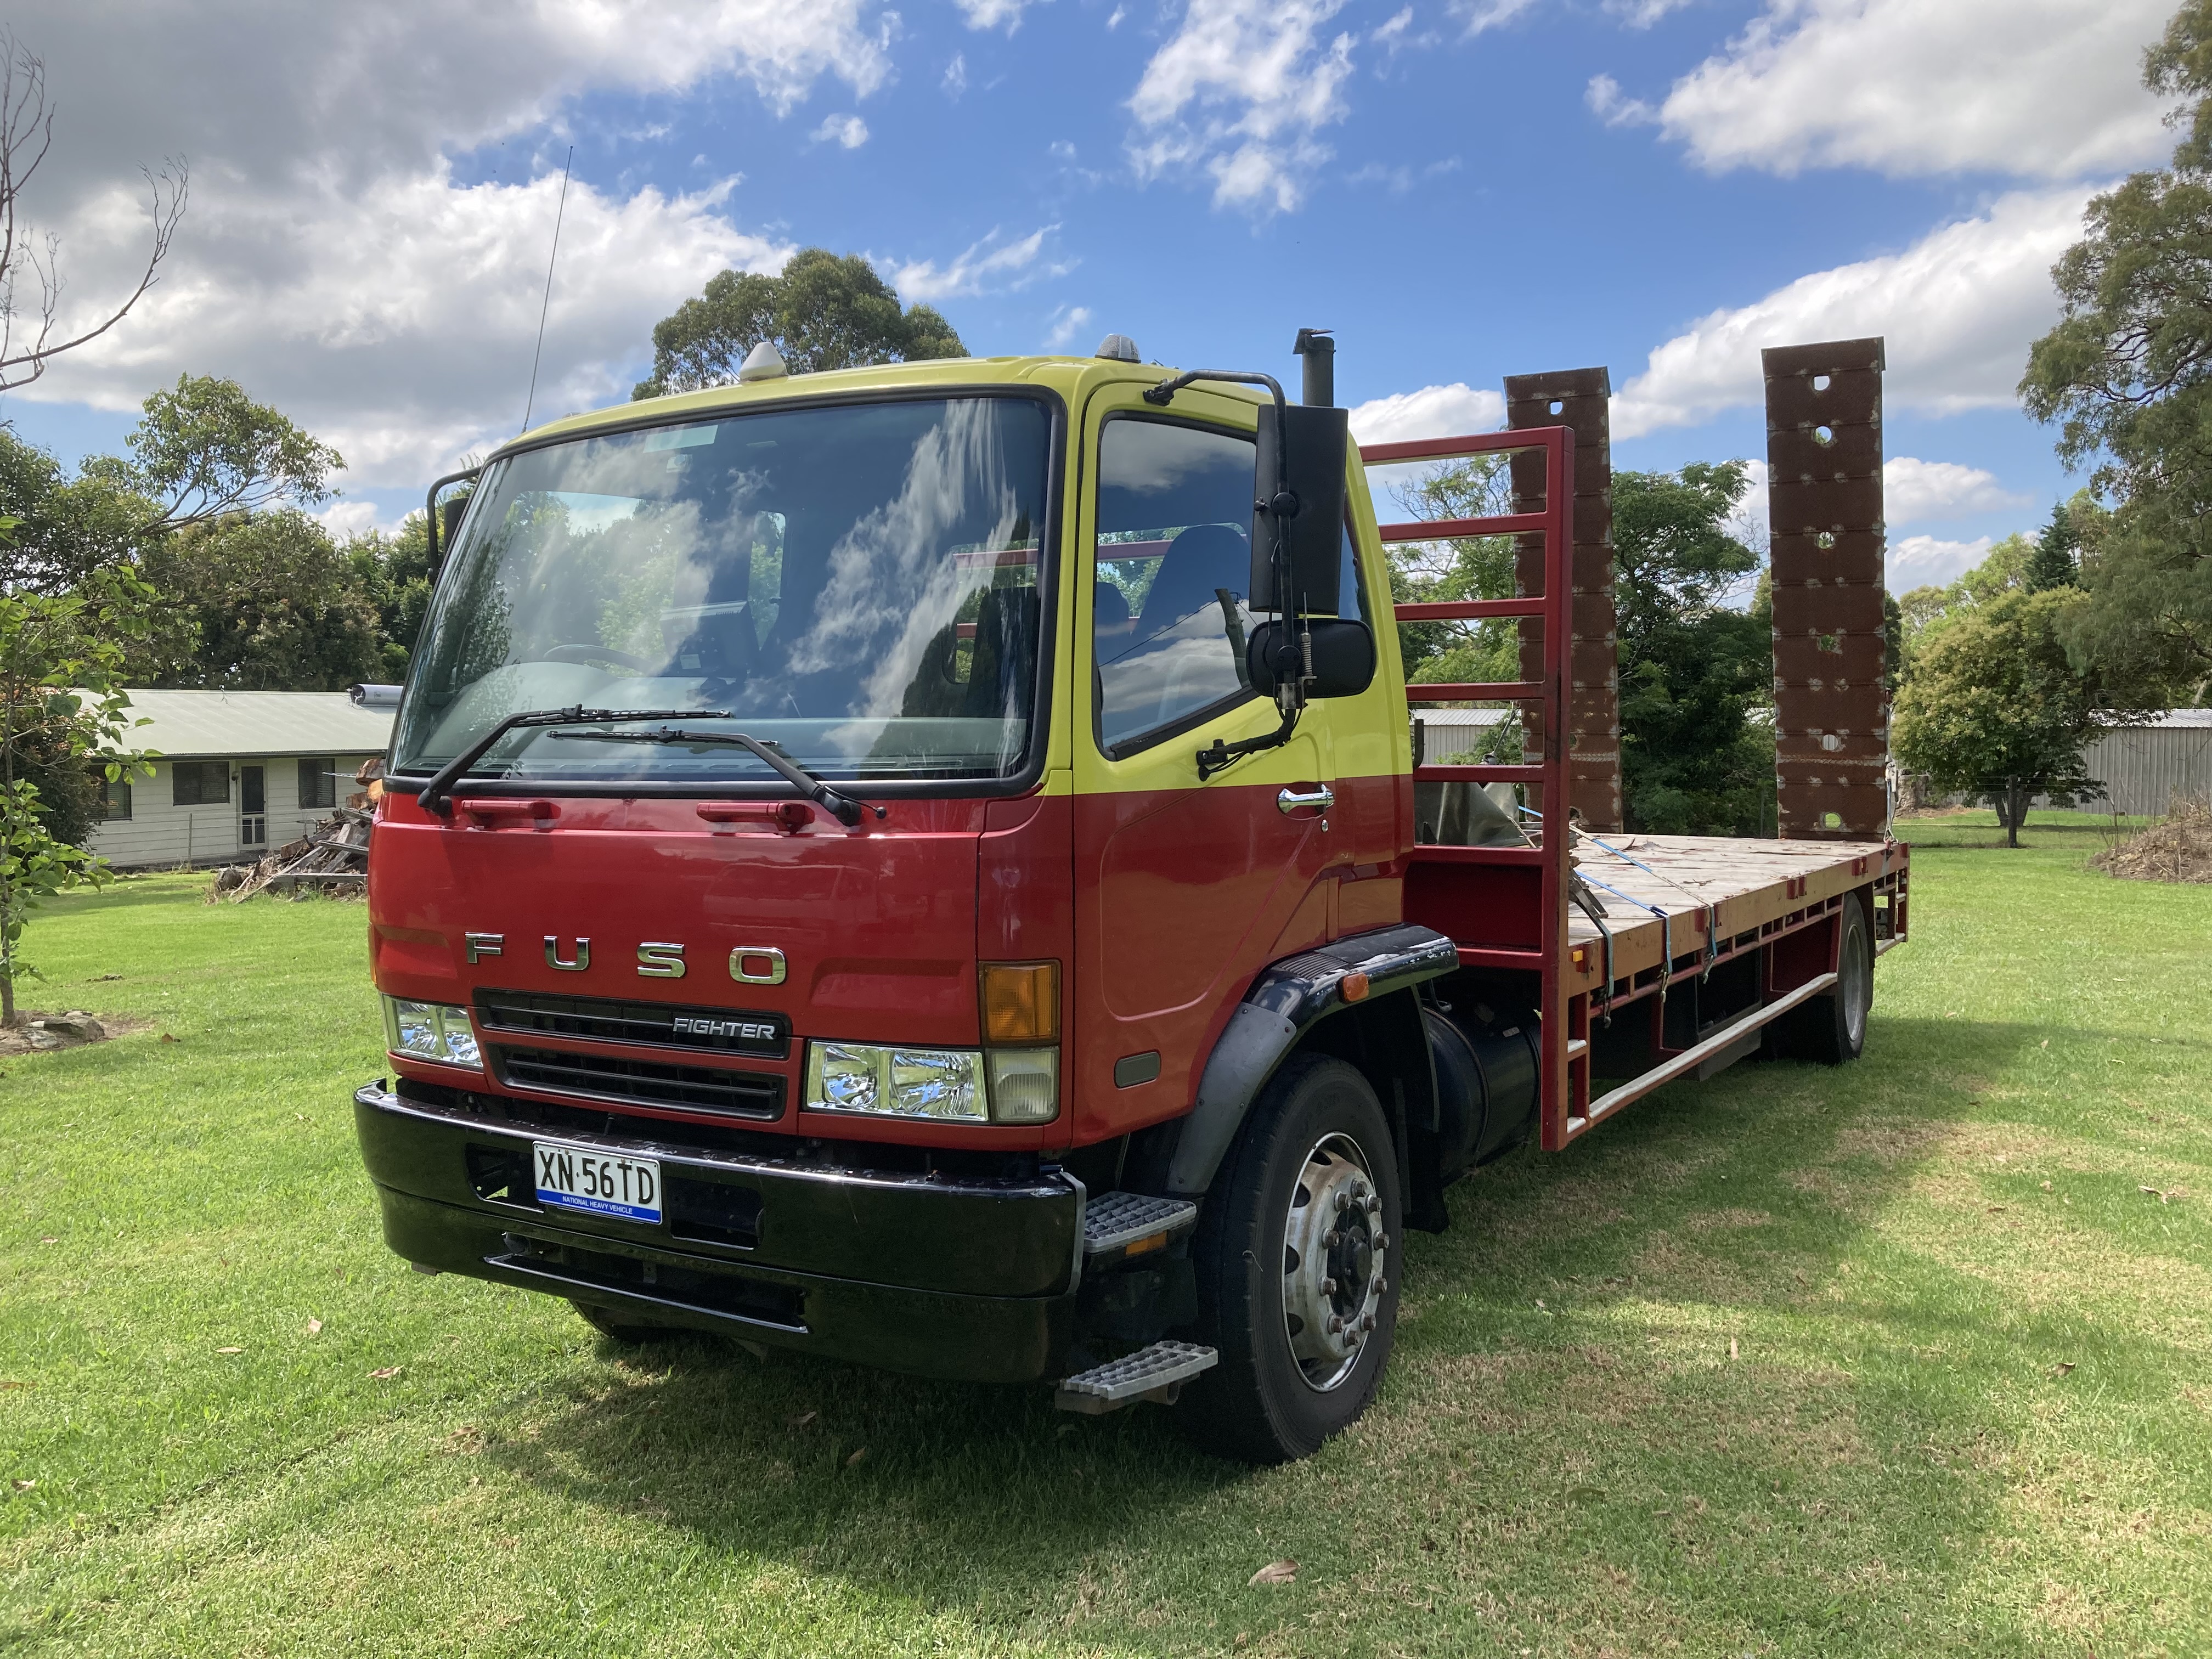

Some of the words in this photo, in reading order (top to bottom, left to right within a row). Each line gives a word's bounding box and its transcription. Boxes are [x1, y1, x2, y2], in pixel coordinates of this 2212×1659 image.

[465, 931, 788, 985] FUSO
[672, 1018, 776, 1040] FIGHTER
[562, 1195, 589, 1207] NATIONAL
[589, 1200, 609, 1211] HEAVY
[609, 1204, 633, 1215] VEHICLE
